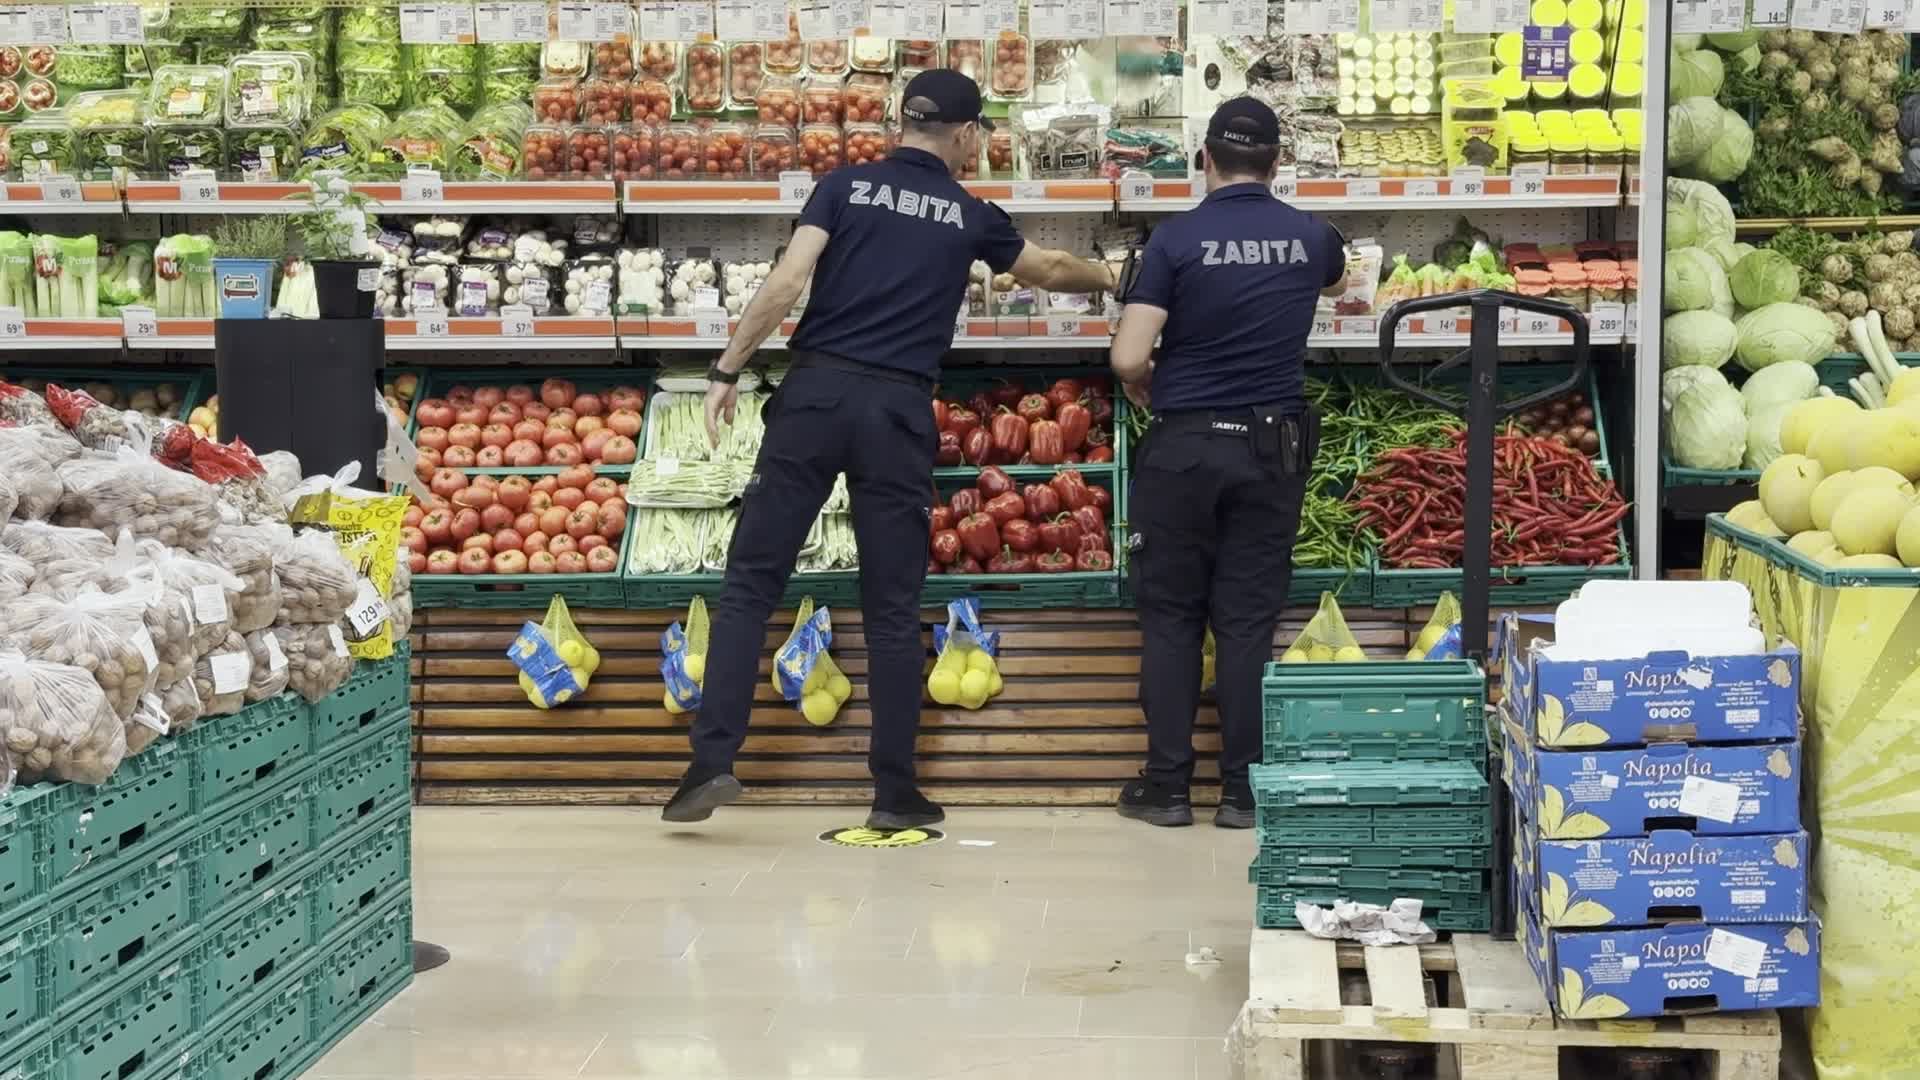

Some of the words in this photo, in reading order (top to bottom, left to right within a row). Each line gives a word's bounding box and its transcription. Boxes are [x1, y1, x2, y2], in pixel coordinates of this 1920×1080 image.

[849, 180, 963, 229] ZABITA
[1201, 239, 1308, 265] ZABITA
[1624, 665, 1690, 695] Napo
[1624, 754, 1712, 785] Napolia
[1628, 843, 1717, 874] Napolia
[1642, 934, 1712, 966] Napol
